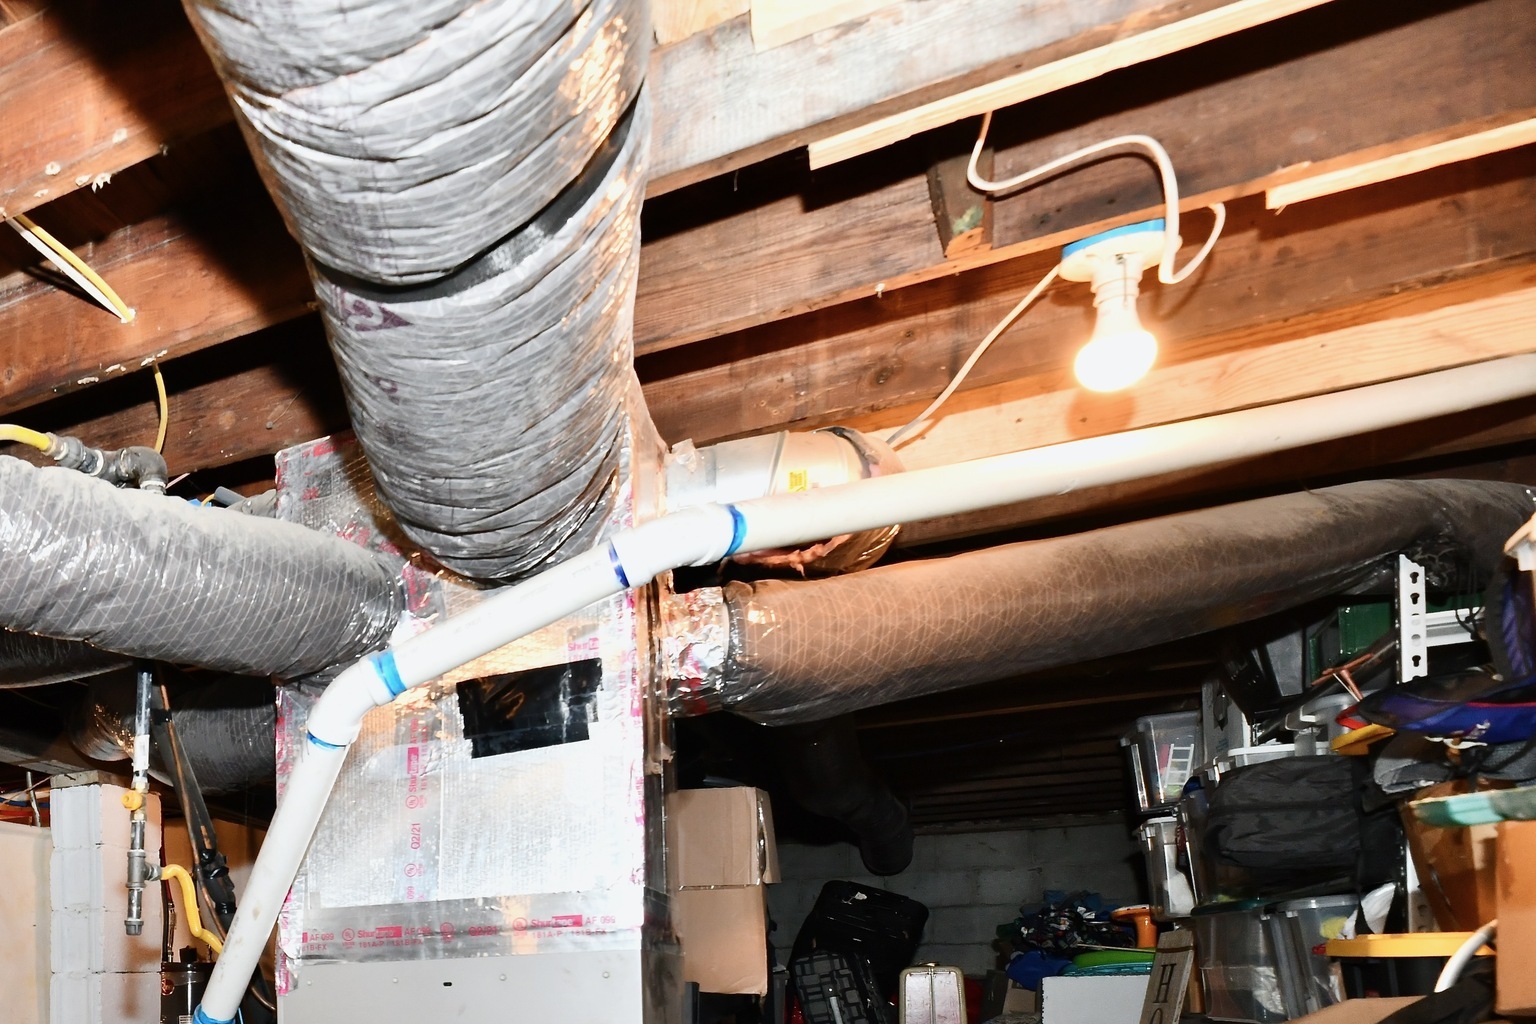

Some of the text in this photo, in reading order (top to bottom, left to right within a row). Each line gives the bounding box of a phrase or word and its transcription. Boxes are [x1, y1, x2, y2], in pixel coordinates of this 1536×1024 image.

[310, 934, 320, 942] AF
[321, 933, 334, 941] 099
[358, 926, 402, 938] Shurtape
[530, 914, 582, 928] Shurtape
